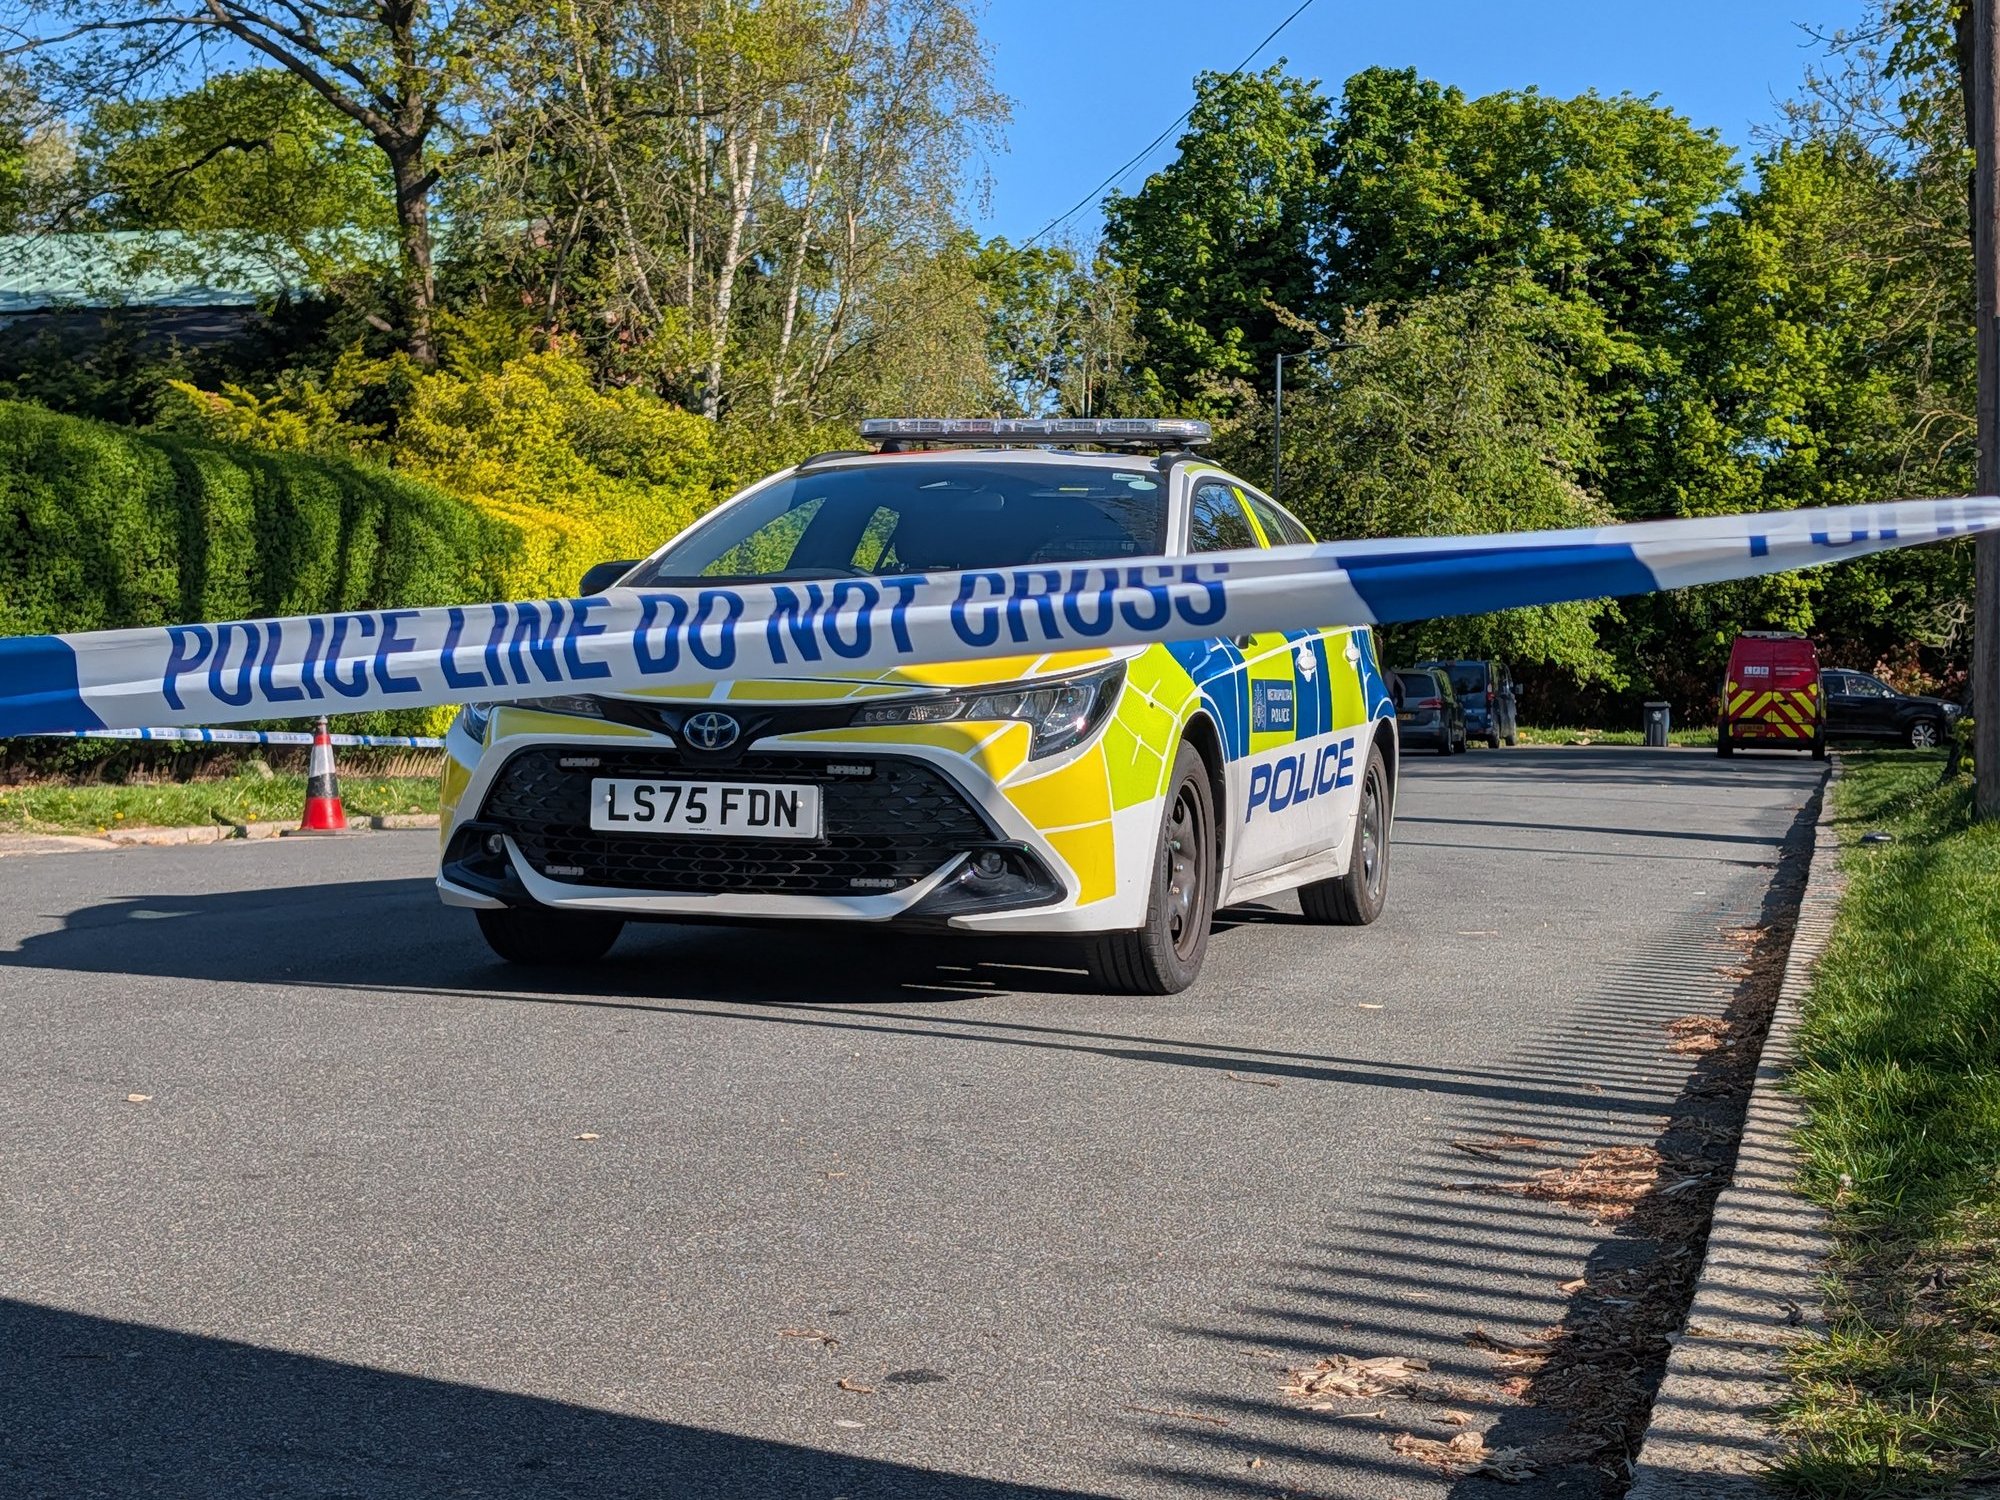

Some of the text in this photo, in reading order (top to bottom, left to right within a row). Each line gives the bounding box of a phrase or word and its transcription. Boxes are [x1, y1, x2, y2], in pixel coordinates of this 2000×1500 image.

[163, 563, 1229, 710] POLICE LINE DO NOT CROSS
[1271, 707, 1290, 723] POLICE
[608, 784, 798, 828] LS75 FDN
[1245, 737, 1354, 823] POLICE
